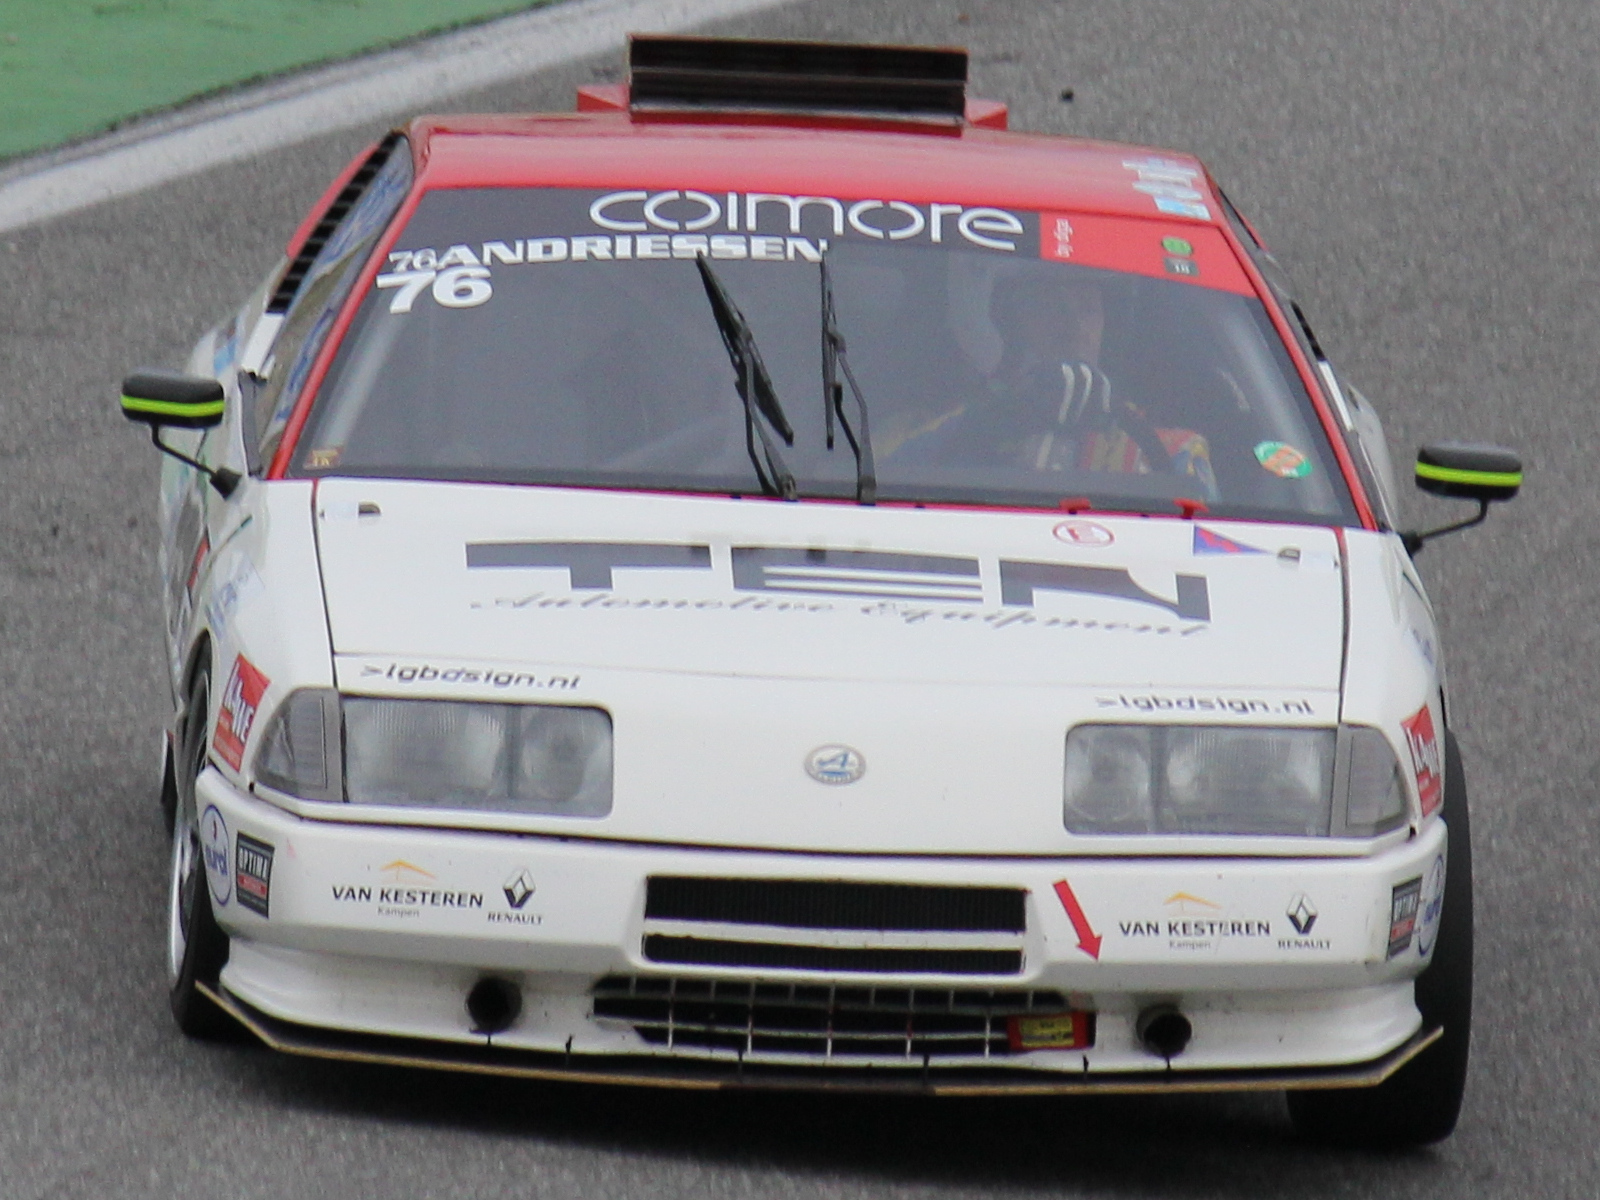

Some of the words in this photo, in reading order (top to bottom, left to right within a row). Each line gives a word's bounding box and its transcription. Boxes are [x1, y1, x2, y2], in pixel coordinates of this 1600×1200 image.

[589, 190, 1024, 251] colmore
[389, 248, 438, 271] 76
[436, 233, 828, 270] ANDRIESSEN
[376, 266, 493, 314] 76
[465, 542, 1212, 622] TEN
[332, 885, 372, 902] VAN
[379, 887, 484, 908] KESTEREN
[487, 911, 544, 926] RENAULT
[1119, 920, 1160, 937] VAN
[1168, 920, 1271, 937] KESTEREN
[1277, 939, 1331, 950] RENAULT
